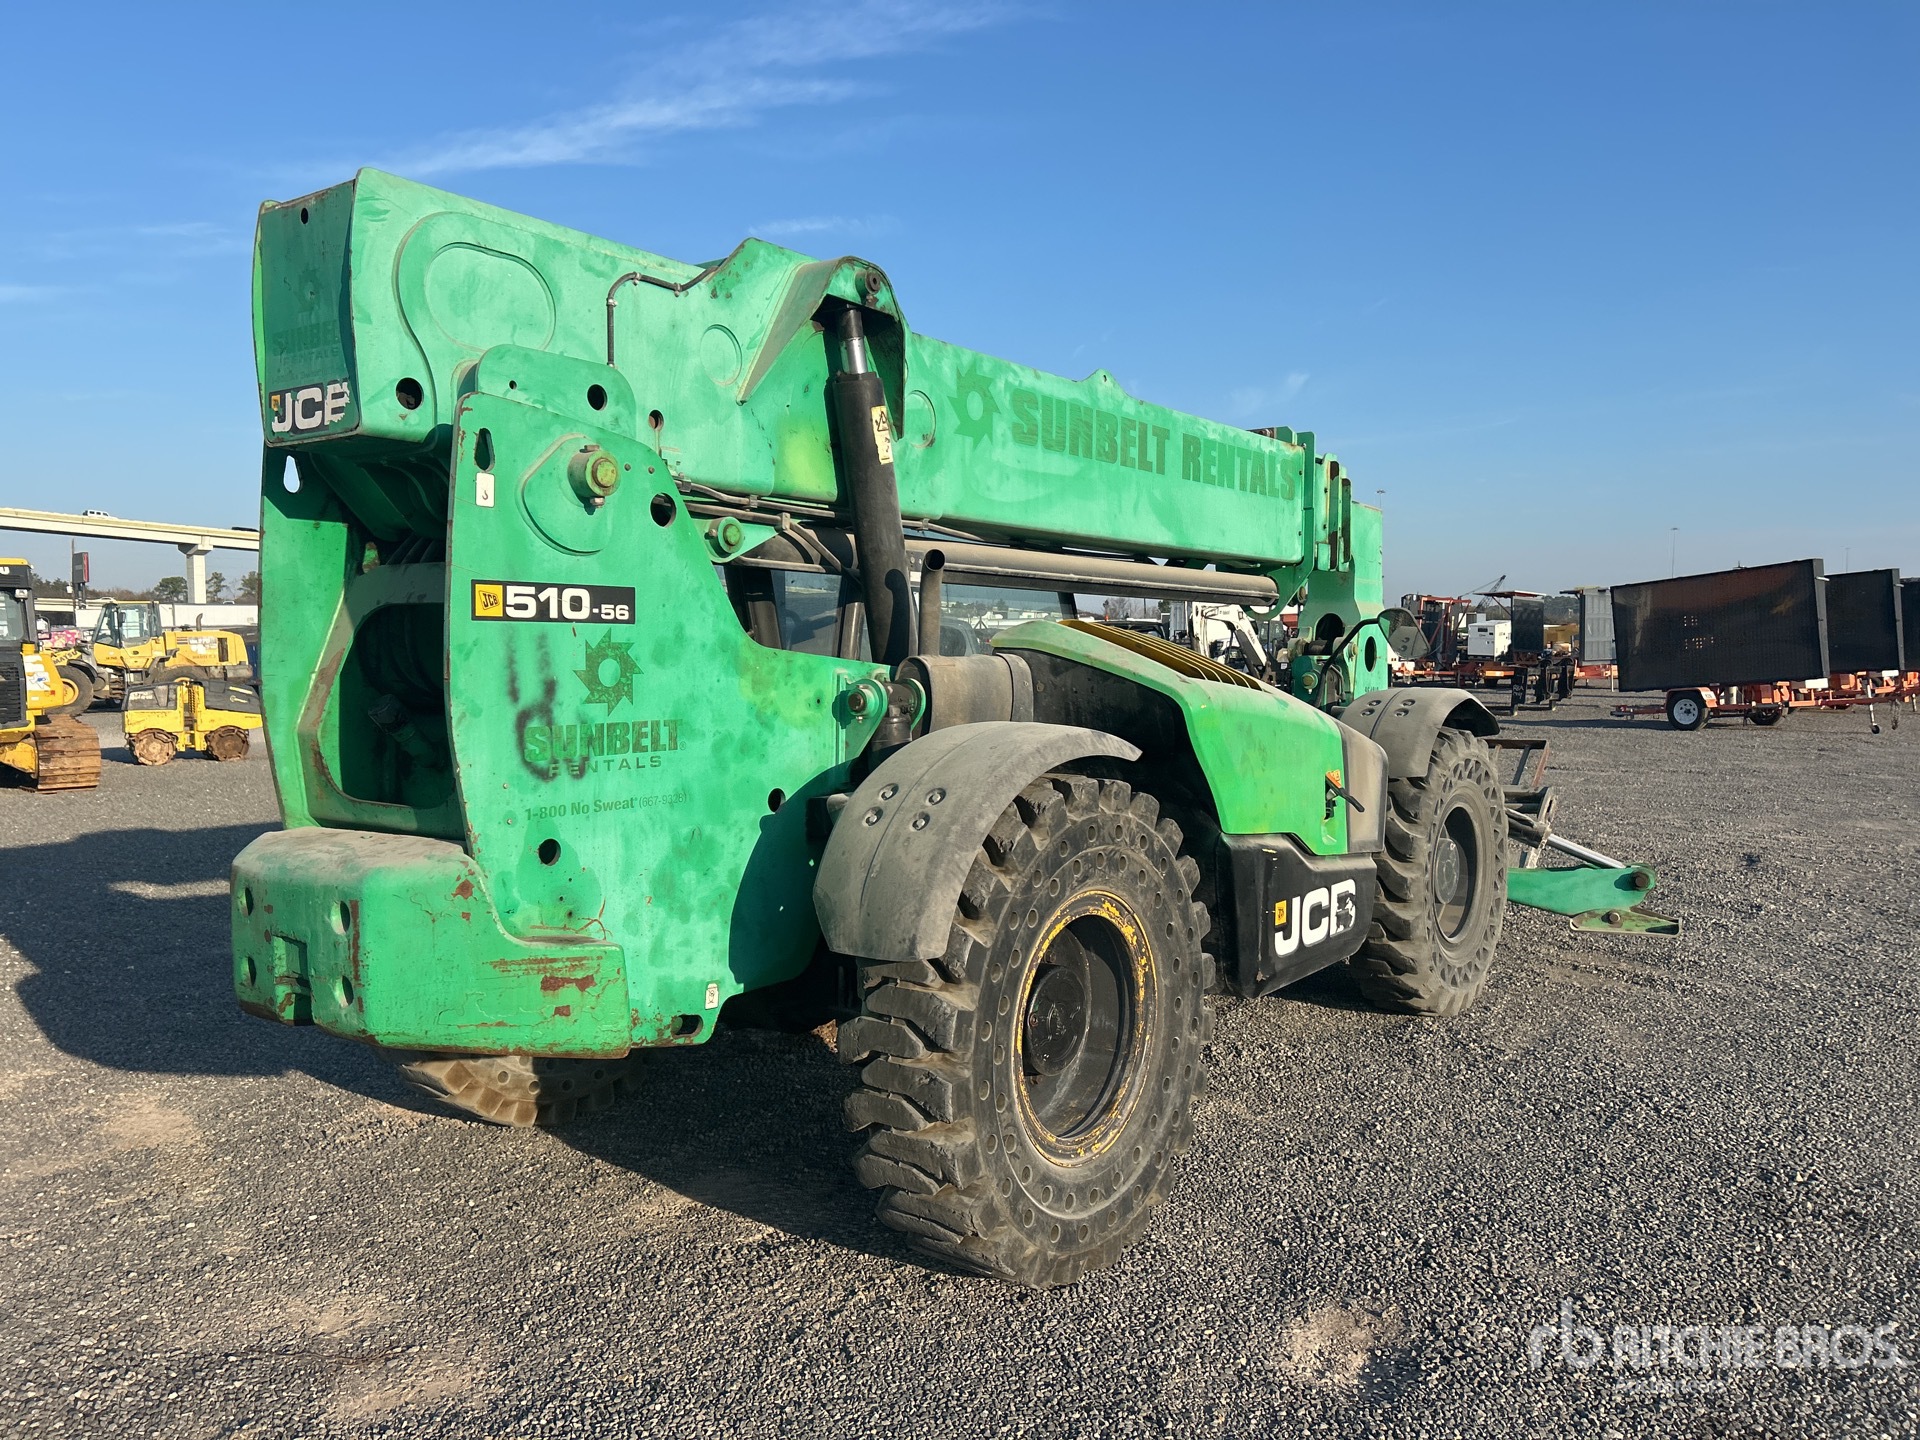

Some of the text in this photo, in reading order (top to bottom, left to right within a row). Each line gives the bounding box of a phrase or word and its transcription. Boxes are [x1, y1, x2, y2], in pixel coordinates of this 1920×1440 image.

[1011, 387, 1296, 500] SUNBELT RENTALS
[482, 592, 498, 607] JCB
[549, 755, 662, 777] RENTALS
[525, 804, 567, 820] 1-800
[571, 801, 590, 815] No
